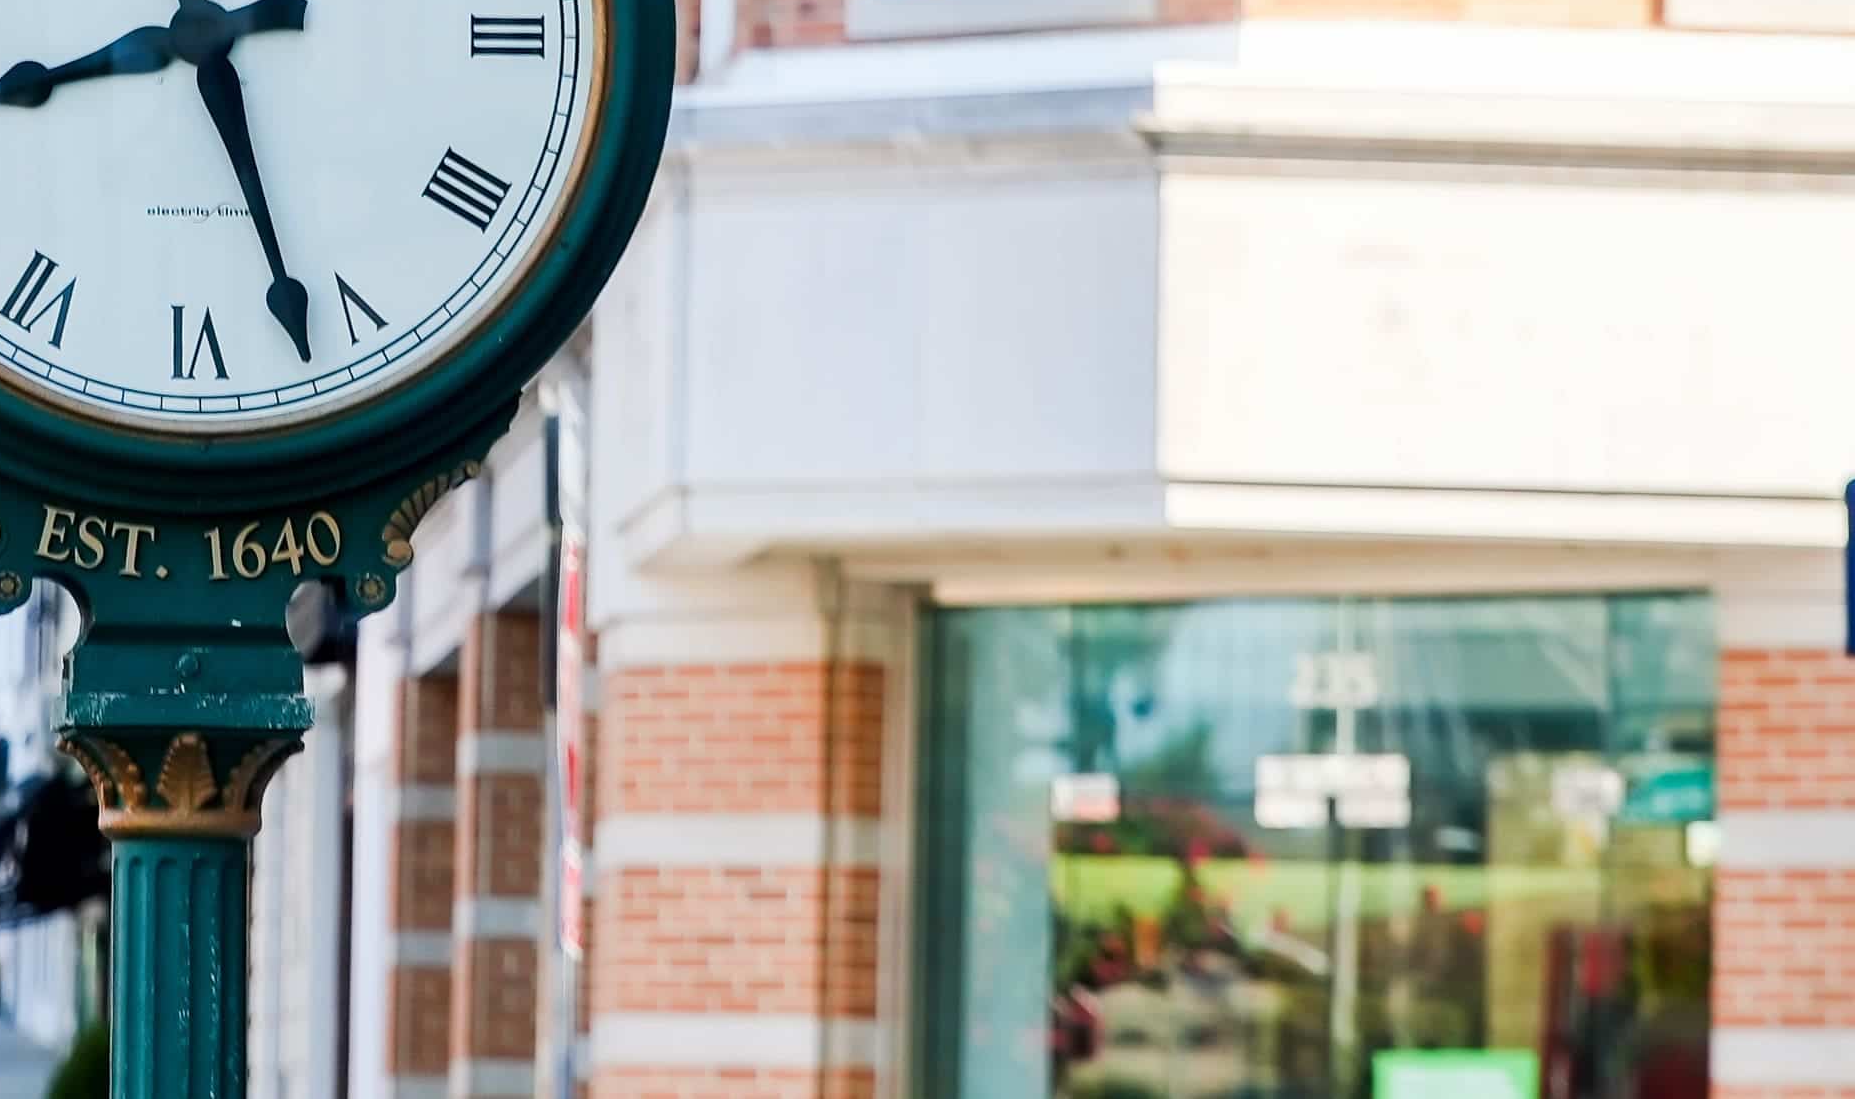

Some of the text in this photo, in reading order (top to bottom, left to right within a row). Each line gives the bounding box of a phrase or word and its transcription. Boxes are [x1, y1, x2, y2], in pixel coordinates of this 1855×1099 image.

[470, 13, 546, 59] III
[420, 145, 513, 233] IIII
[171, 305, 230, 380] VI
[334, 269, 390, 346] V
[36, 505, 342, 581] EST. 1640
